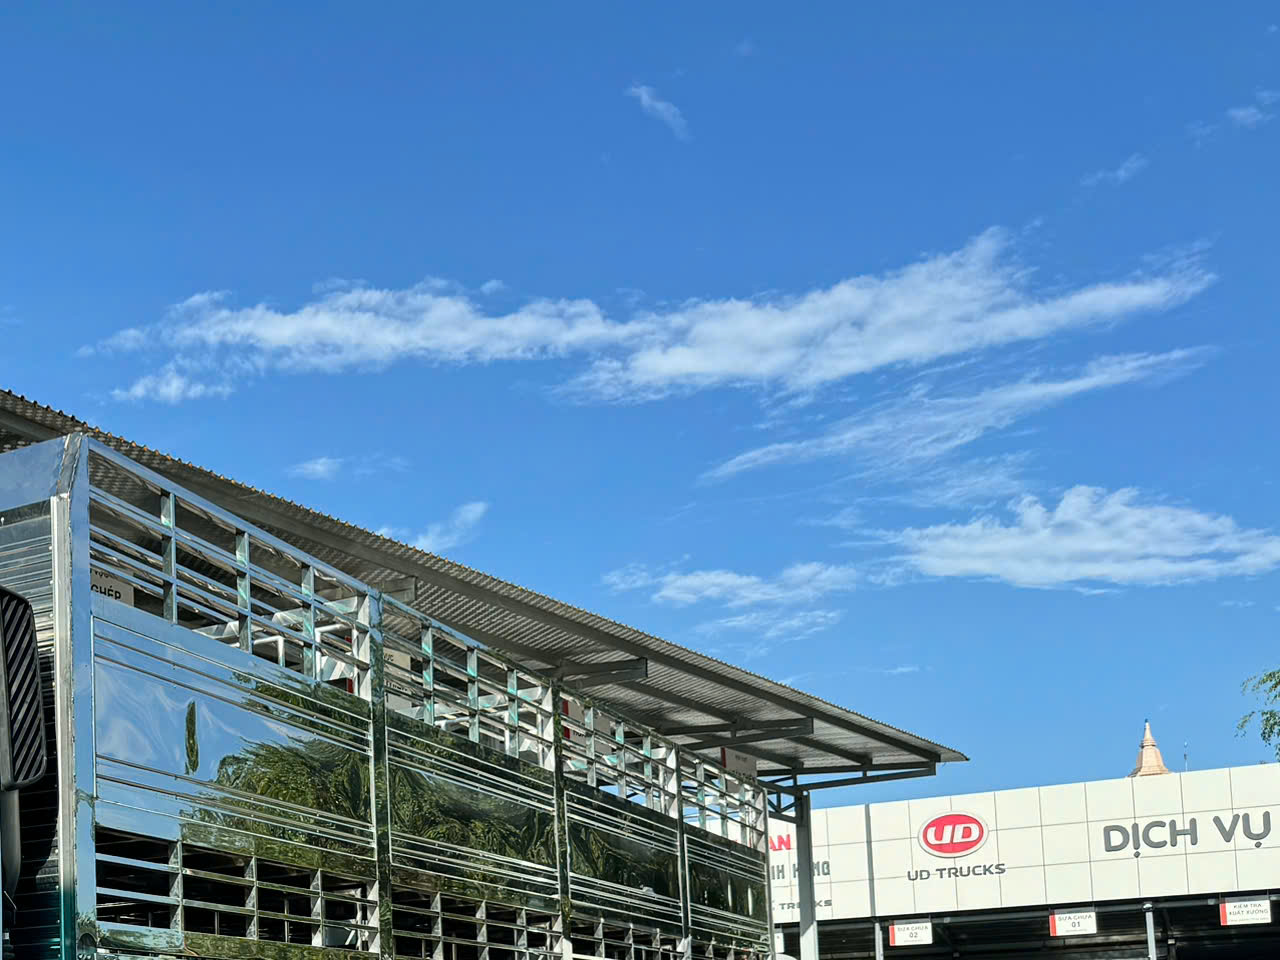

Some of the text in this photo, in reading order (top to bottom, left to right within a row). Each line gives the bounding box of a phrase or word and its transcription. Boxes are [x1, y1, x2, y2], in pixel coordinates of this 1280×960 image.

[926, 822, 980, 845] UD
[1103, 810, 1272, 859] DỊCH VỤ
[907, 863, 1006, 881] UD TRUCKS
[909, 931, 918, 939] 02
